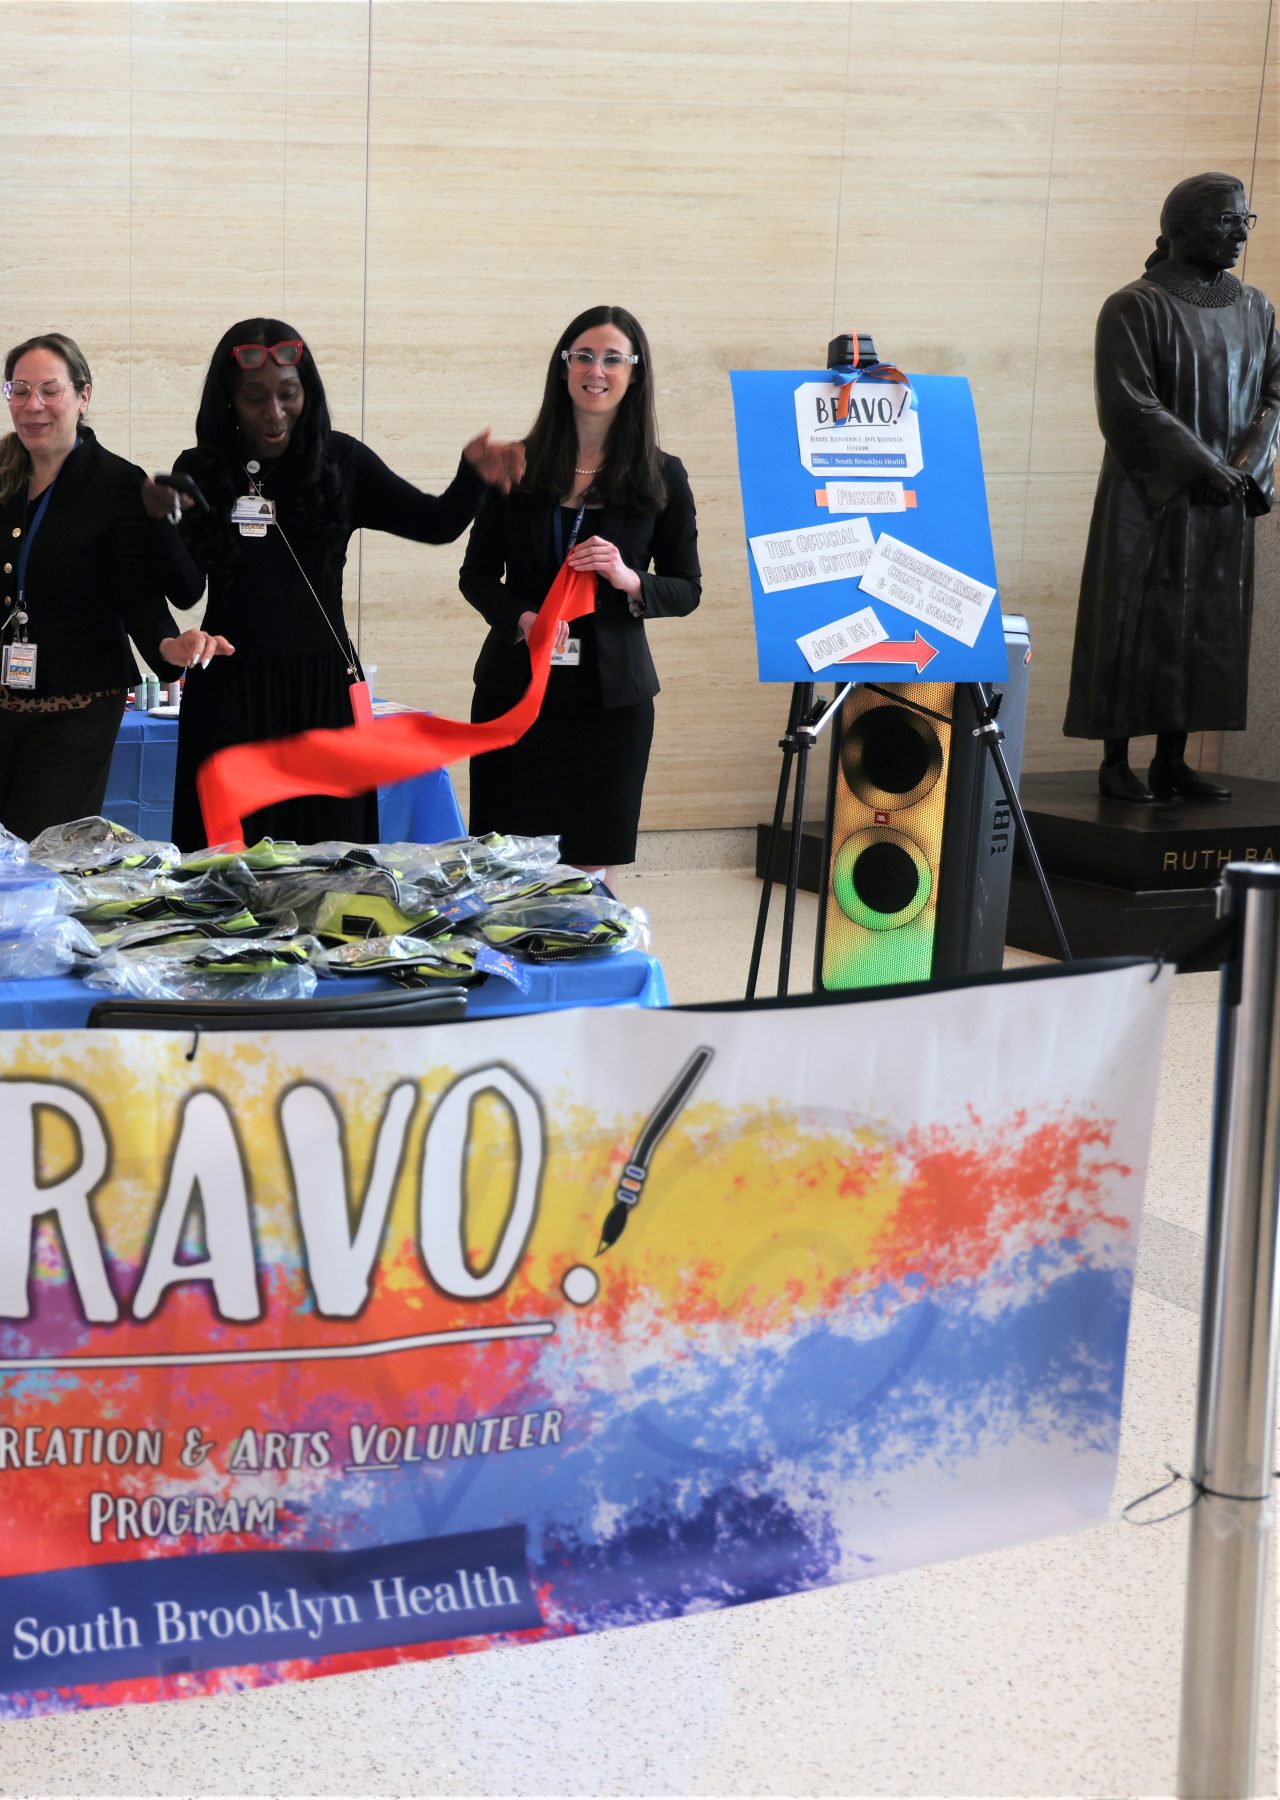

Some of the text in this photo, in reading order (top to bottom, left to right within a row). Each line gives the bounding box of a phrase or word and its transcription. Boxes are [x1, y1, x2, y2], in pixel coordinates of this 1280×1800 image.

[854, 458, 884, 466] Brooklyn
[765, 527, 859, 559] THE OFFICIAL
[763, 565, 817, 586] RIBBON
[813, 633, 847, 659] JOIN
[1163, 849, 1232, 871] RUTH
[180, 1428, 215, 1468] &
[230, 1428, 332, 1475] ARTS
[346, 1410, 564, 1473] VOLUNTEER
[89, 1492, 278, 1543] PROGRAM
[13, 1565, 523, 1661] South Brooklyn Health
